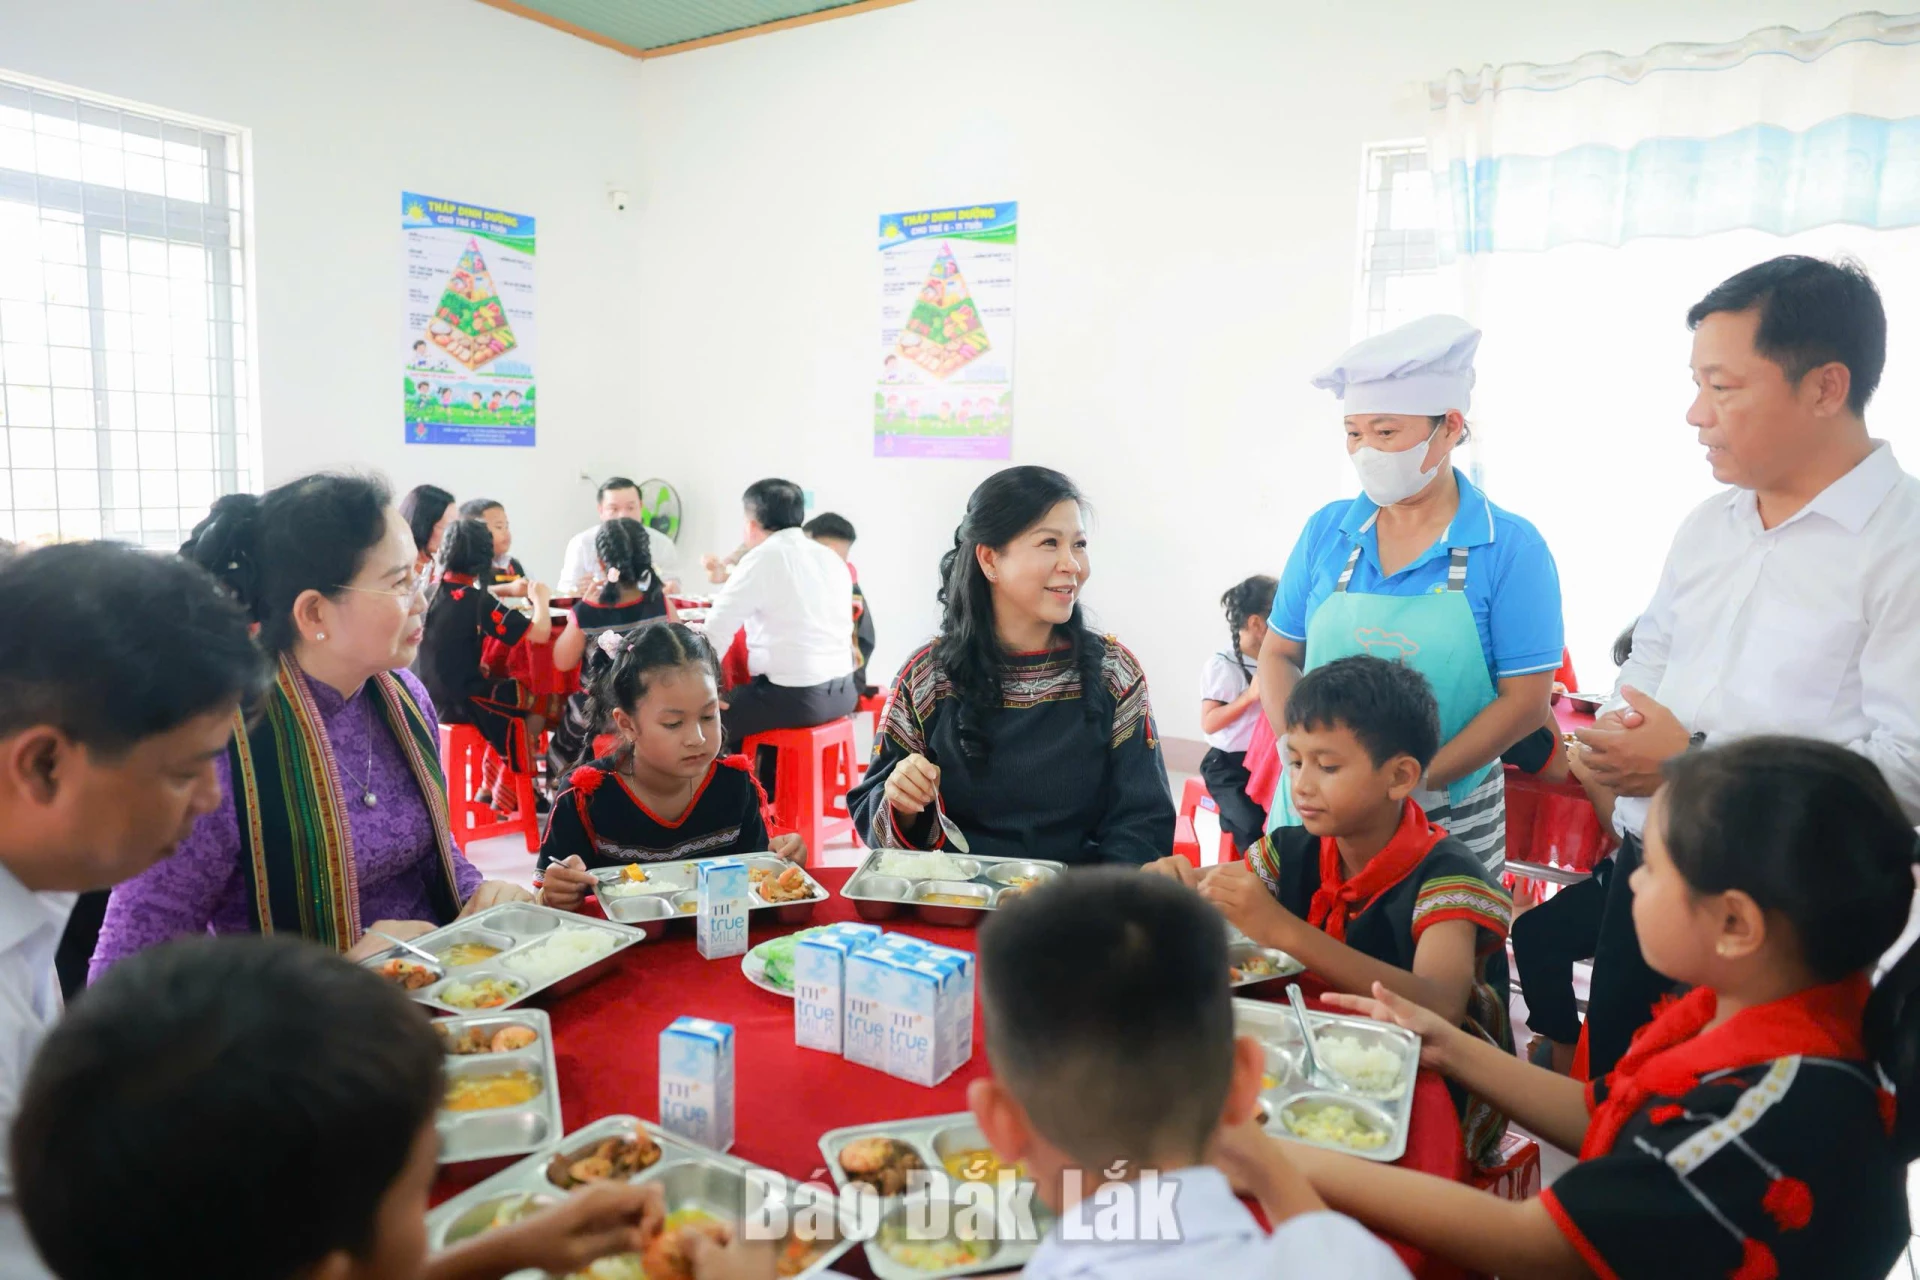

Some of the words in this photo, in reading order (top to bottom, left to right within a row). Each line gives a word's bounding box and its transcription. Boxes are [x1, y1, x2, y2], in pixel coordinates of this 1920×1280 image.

[711, 916, 745, 932] true
[711, 929, 745, 944] MILK
[798, 999, 835, 1021] true
[847, 1013, 885, 1035] true
[889, 1026, 929, 1052] true
[663, 1096, 708, 1123] true
